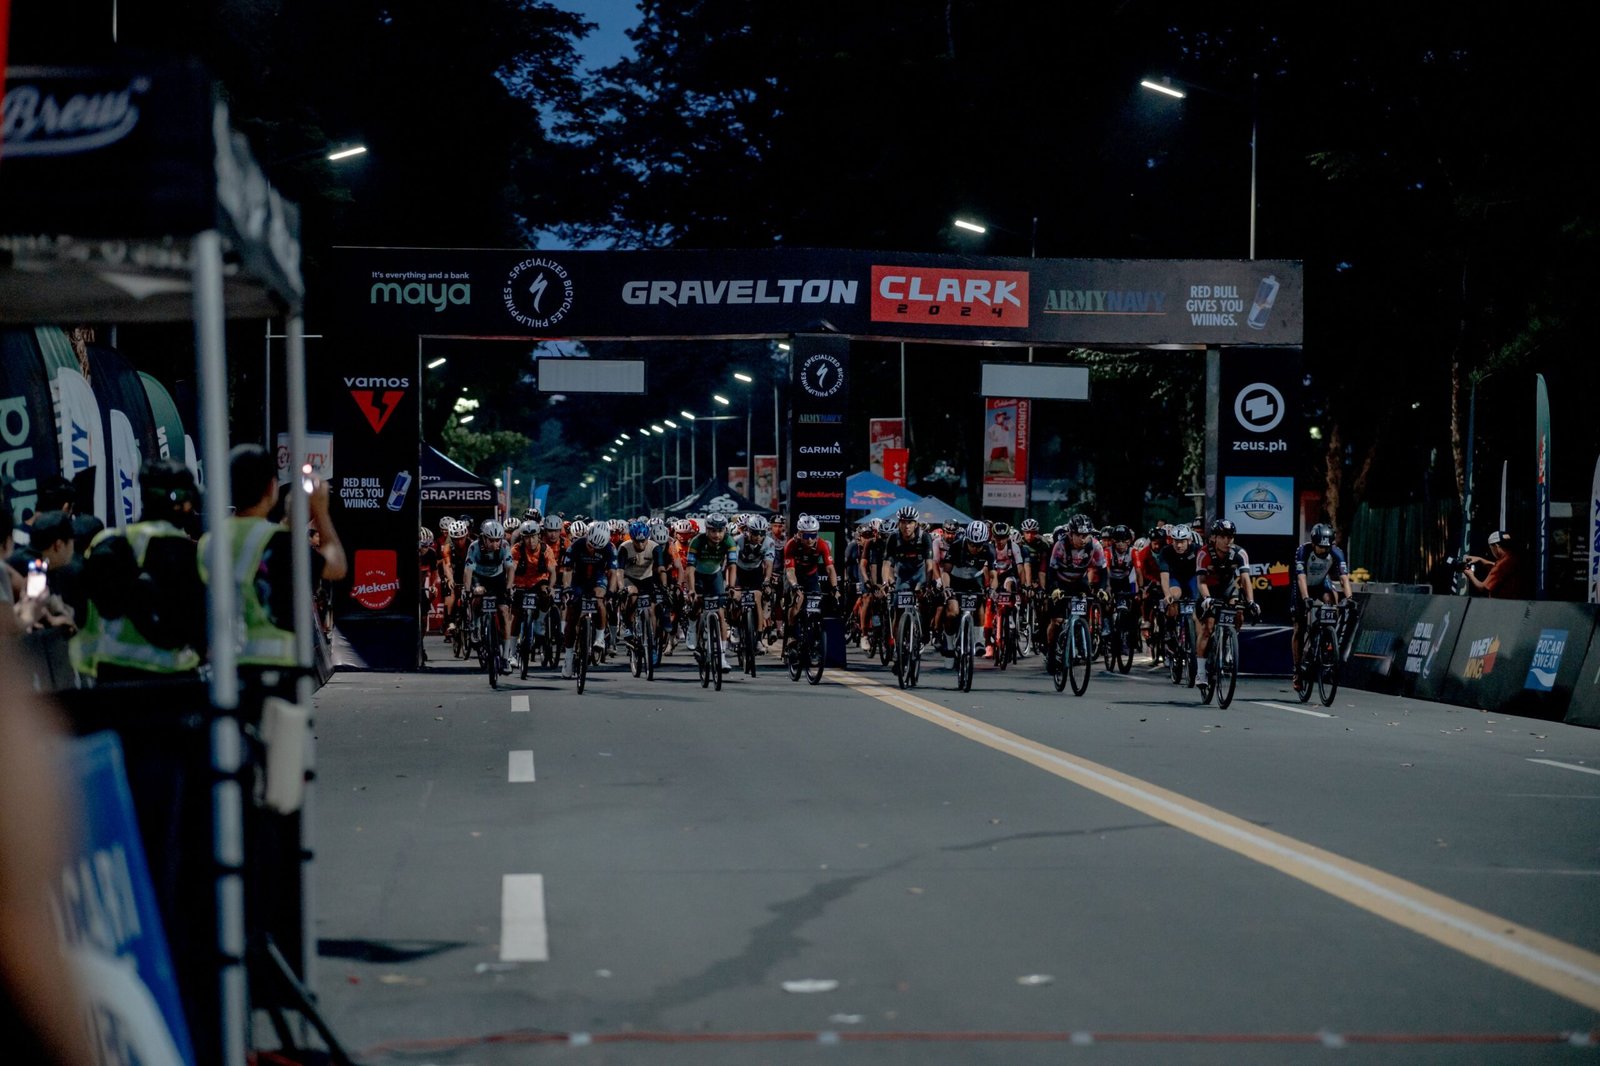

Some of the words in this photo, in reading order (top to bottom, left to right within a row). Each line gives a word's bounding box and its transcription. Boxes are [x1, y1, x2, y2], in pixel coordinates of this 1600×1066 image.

[371, 271, 384, 279] It's
[385, 271, 427, 281] everything
[428, 271, 443, 279] and
[450, 271, 470, 280] bank
[509, 257, 568, 280] SPECIALIZED
[370, 282, 471, 313] maya
[621, 278, 859, 309] GRAVELTON
[879, 275, 1021, 308] CLARK
[1190, 285, 1211, 298] RED
[1213, 285, 1239, 298] BULL
[503, 287, 549, 328] PHILIPPINES
[549, 279, 574, 325] BICYCLES
[1043, 288, 1167, 313] ARMYNAVY
[1186, 299, 1217, 313] GIVES
[1219, 299, 1244, 313] YOU
[896, 303, 1003, 318] 2024
[1191, 313, 1239, 327] WIIINGS.
[804, 353, 840, 370] SPECIALIZED
[343, 376, 410, 389] vamos
[1018, 400, 1028, 450] CURIOSITY
[799, 445, 842, 454] GARMIN
[1232, 439, 1288, 454] zeus.ph
[809, 470, 844, 478] RUDY
[343, 477, 360, 488] RED
[361, 477, 381, 488] BULL
[340, 488, 364, 498] GIVES
[366, 488, 384, 498] YOU
[1234, 503, 1266, 511] PACIFIC
[1267, 503, 1285, 511] BAY
[351, 578, 401, 597] Mekeni
[1075, 602, 1086, 612] 82
[1469, 636, 1494, 657] WHEY
[1536, 640, 1566, 655] POCARI
[1463, 657, 1484, 680] KING
[1531, 653, 1559, 669] SWEAT
